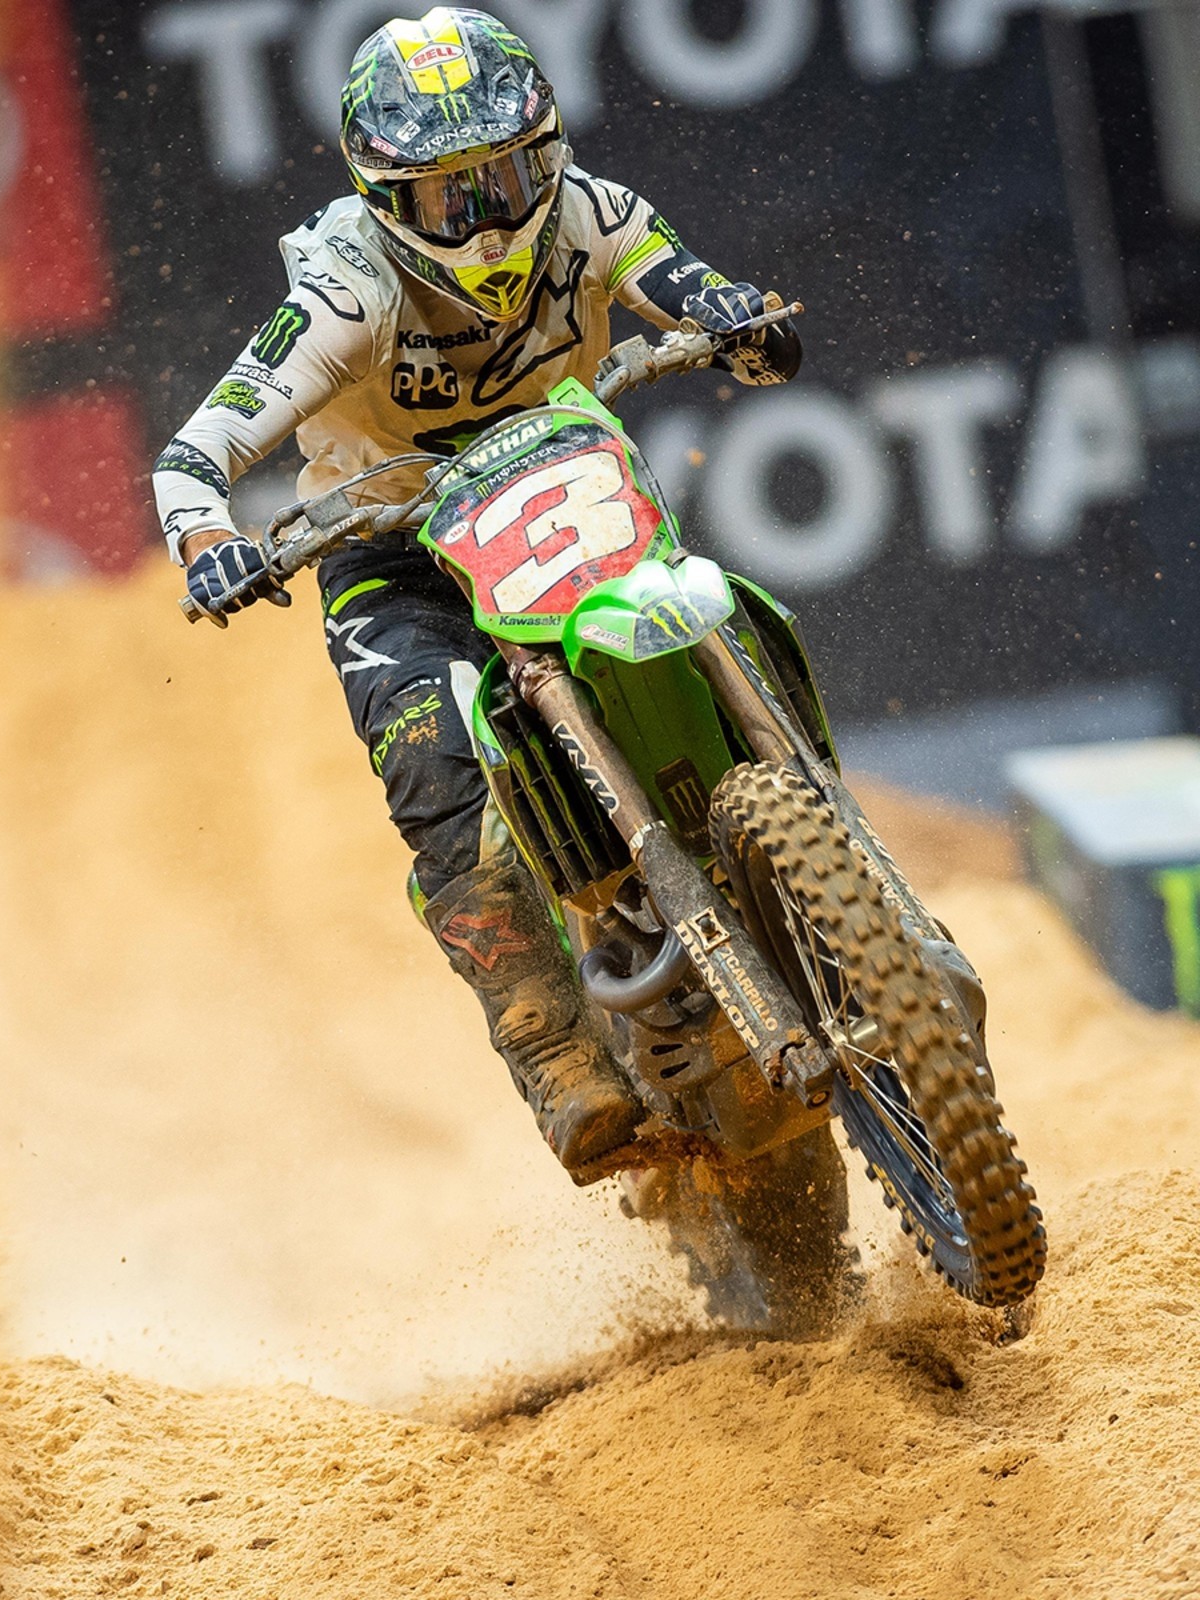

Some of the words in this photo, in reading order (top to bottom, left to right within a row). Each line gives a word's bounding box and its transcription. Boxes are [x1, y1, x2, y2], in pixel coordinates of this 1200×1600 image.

[413, 46, 457, 67] BELL
[414, 121, 514, 155] MONSTER
[397, 324, 492, 351] Kawasaki
[488, 444, 558, 487] MONSTER
[473, 449, 637, 614] 3
[499, 615, 562, 627] Kawasaki
[672, 919, 760, 1049] DUNLOP
[725, 954, 779, 1032] CARRILLO
